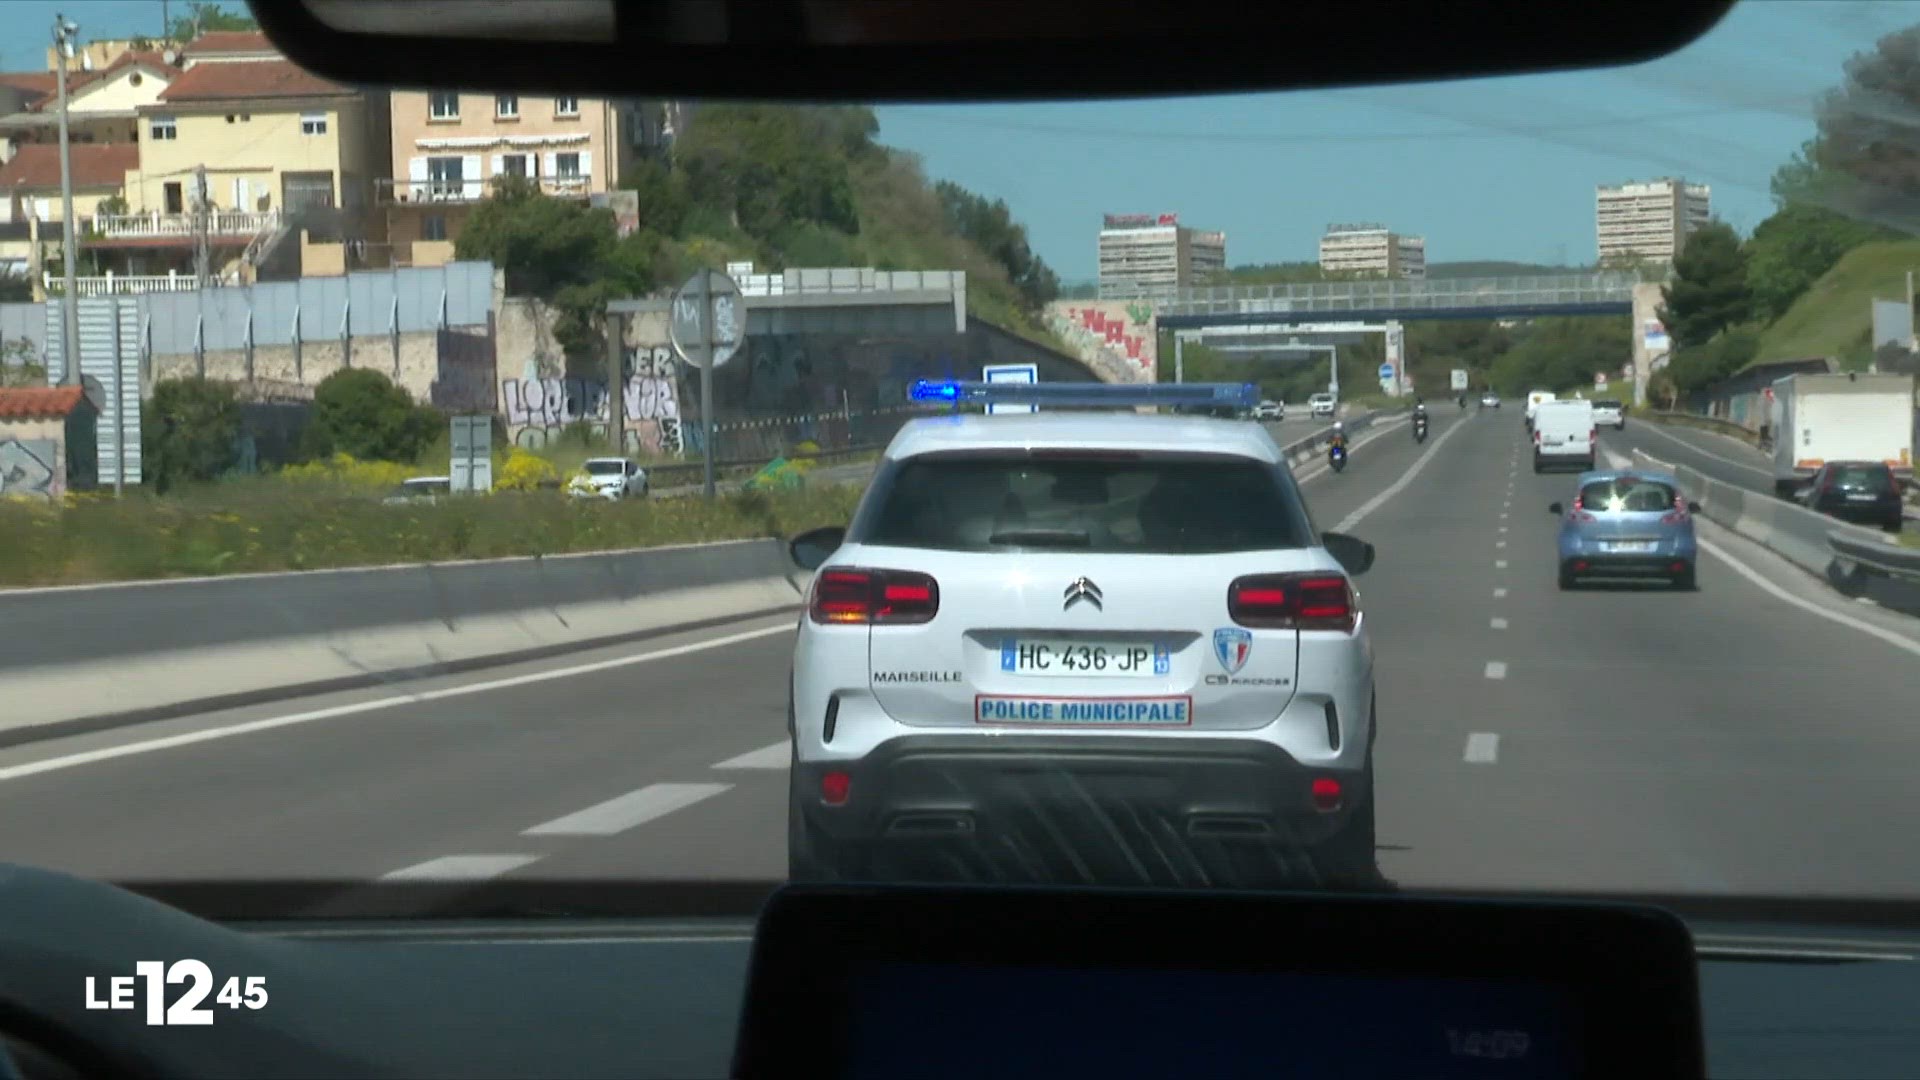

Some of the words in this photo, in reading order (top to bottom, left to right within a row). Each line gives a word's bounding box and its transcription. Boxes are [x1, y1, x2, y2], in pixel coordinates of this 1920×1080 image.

[873, 671, 963, 682] MARSEILLE
[981, 700, 1054, 721] POLICE
[1060, 702, 1186, 722] MUNICIPALE
